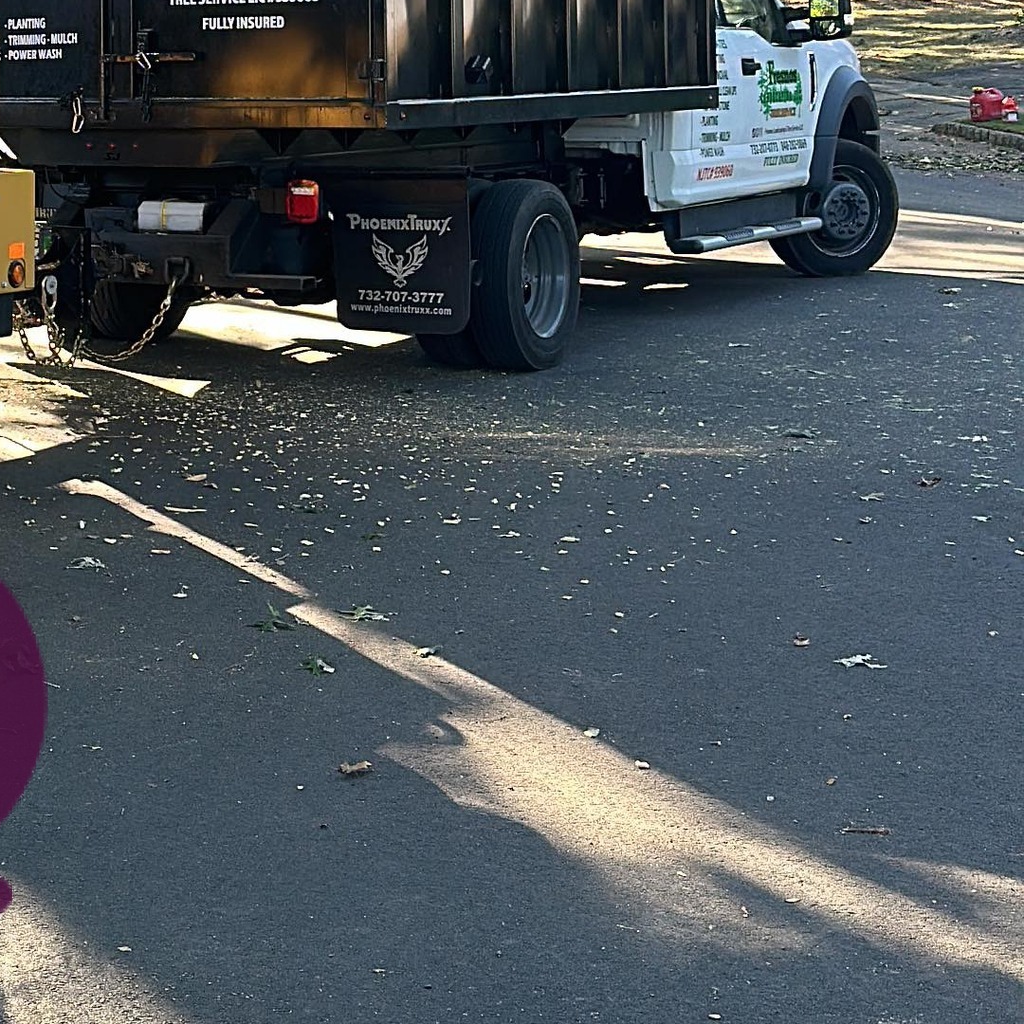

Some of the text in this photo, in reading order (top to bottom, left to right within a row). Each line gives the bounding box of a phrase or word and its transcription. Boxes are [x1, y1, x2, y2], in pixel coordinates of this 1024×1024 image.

[202, 15, 285, 30] FULLY INSURED
[38, 48, 63, 60] WASH
[358, 289, 444, 304] 732-707-3777
[350, 303, 452, 315] www.phoenixtruxx.com
